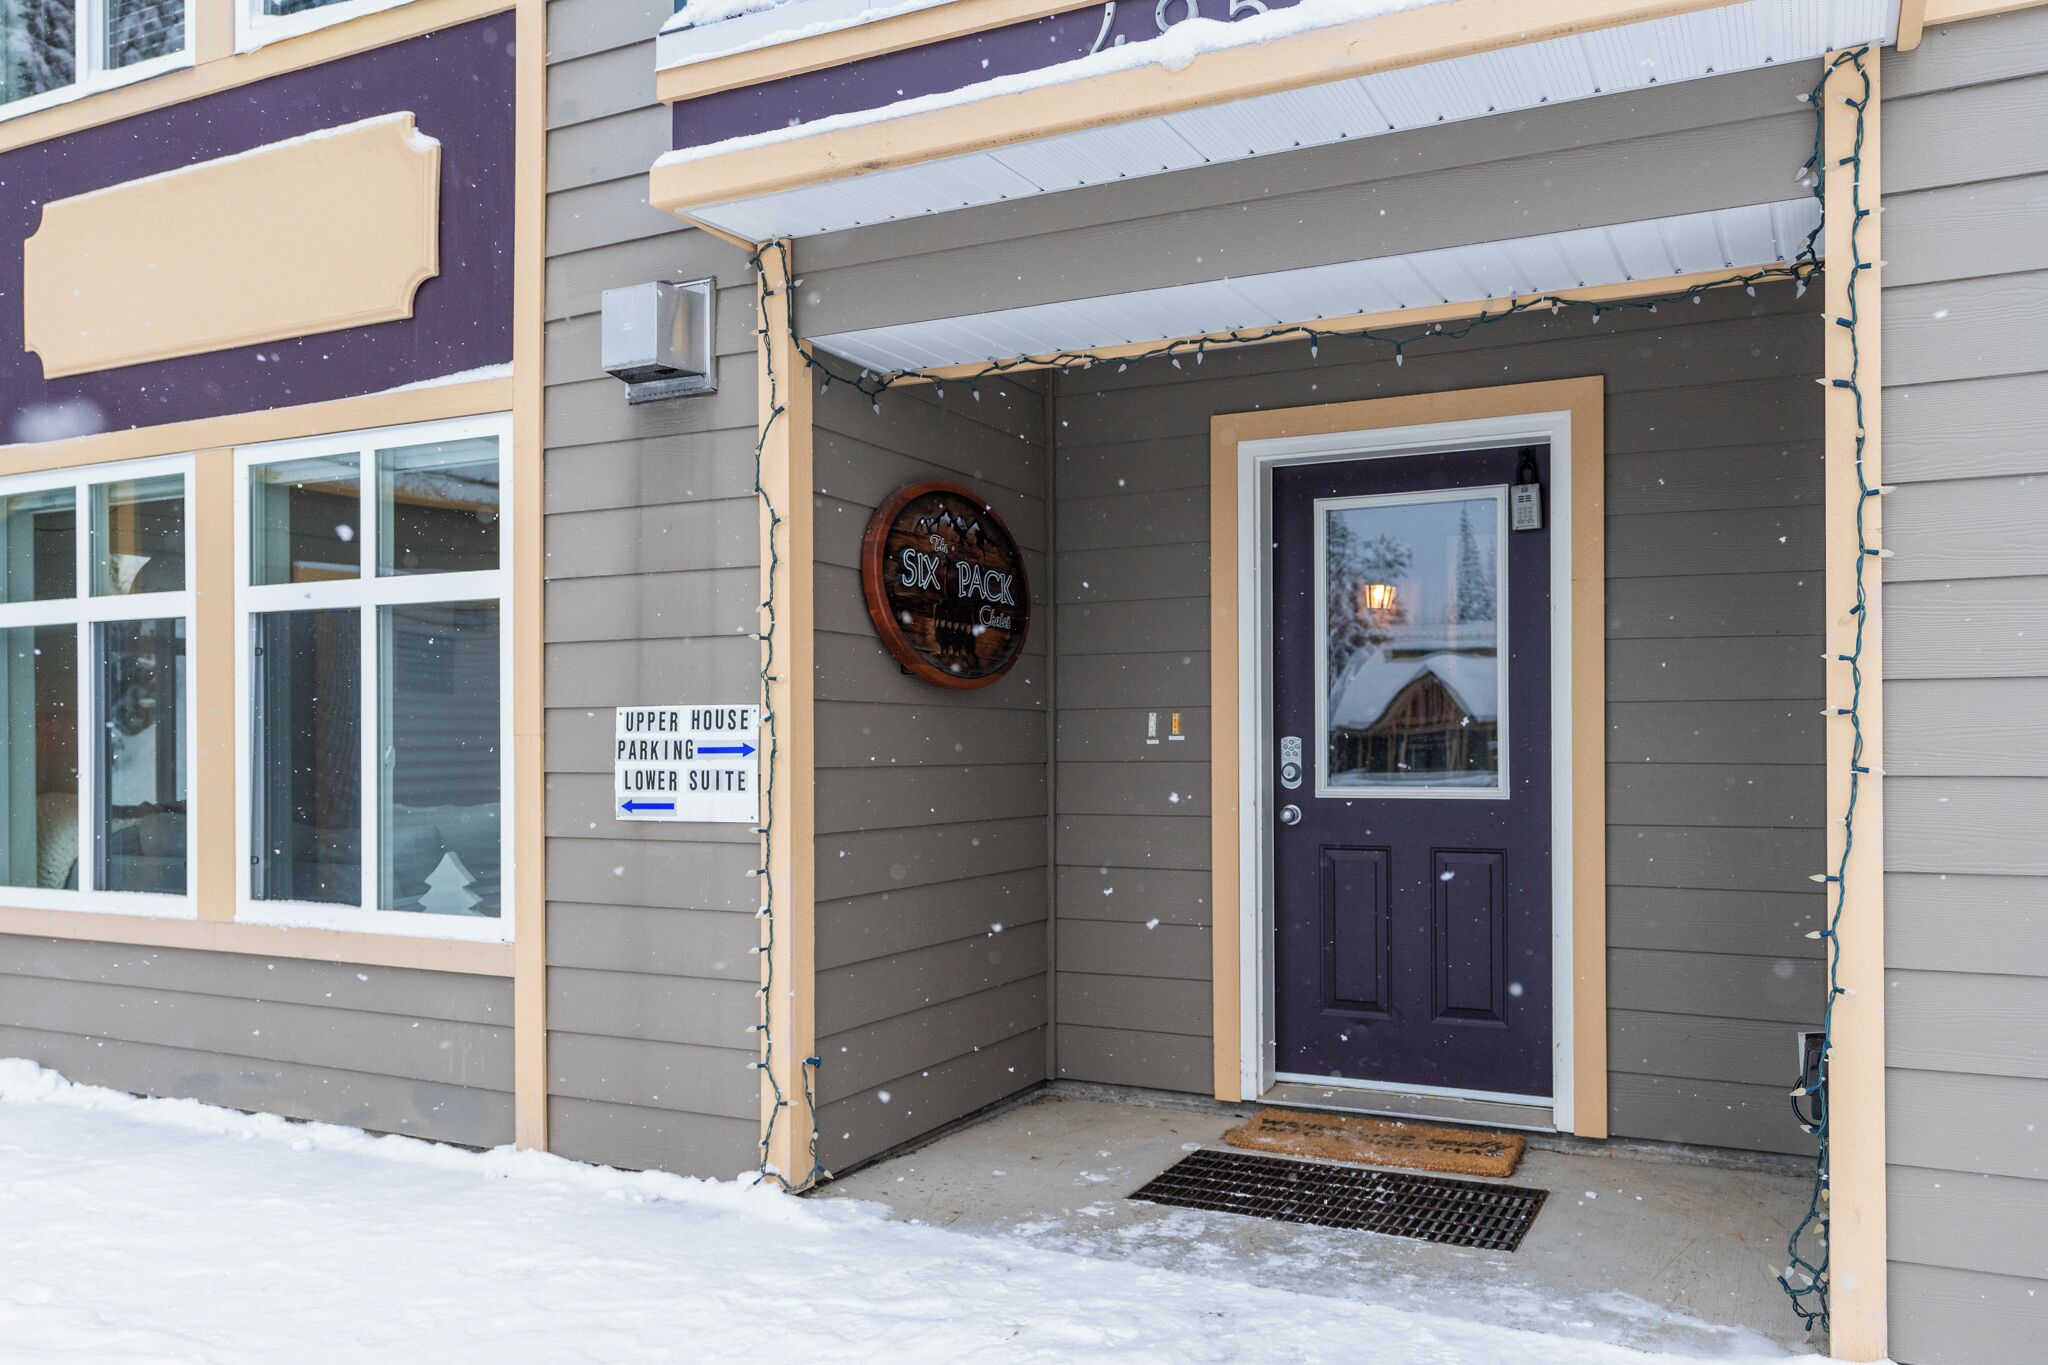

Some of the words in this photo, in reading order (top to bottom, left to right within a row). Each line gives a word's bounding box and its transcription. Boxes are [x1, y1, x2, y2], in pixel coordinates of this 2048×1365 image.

[902, 548, 940, 590] SIX
[956, 560, 1014, 606] PACK
[626, 711, 678, 732] UPPER
[691, 709, 749, 730] HOUSE
[618, 739, 694, 760] PARKING
[624, 770, 677, 791] LOWER
[689, 770, 746, 791] SUITE
